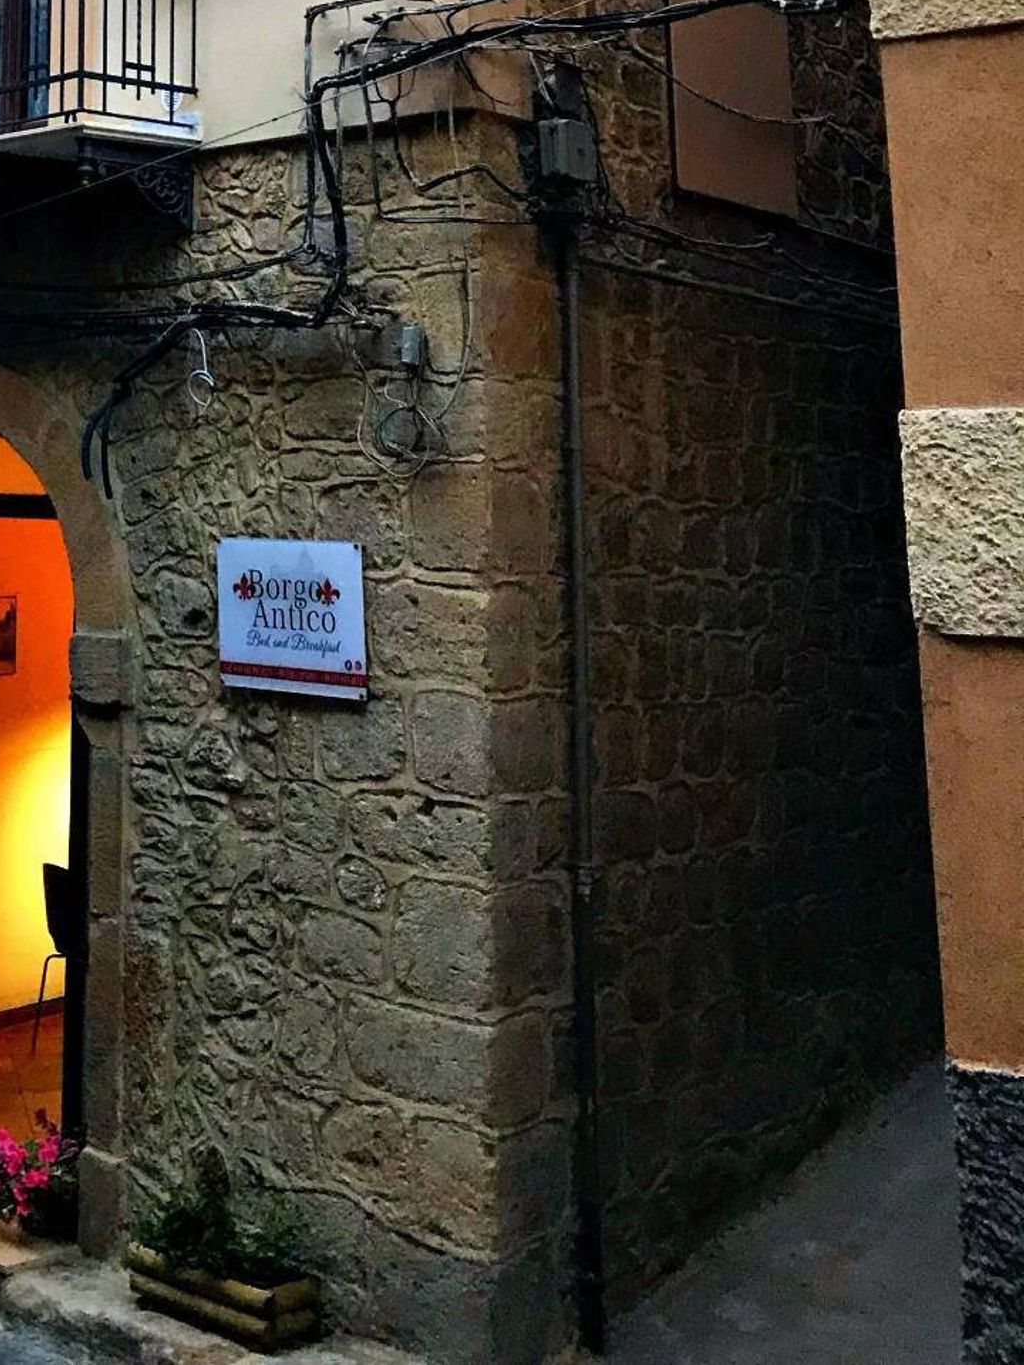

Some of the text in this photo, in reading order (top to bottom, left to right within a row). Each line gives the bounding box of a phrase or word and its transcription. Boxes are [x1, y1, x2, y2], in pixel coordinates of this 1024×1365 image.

[248, 569, 322, 609] Borgo
[253, 600, 336, 634] Antico
[247, 630, 341, 658] Bed and Breakfast
